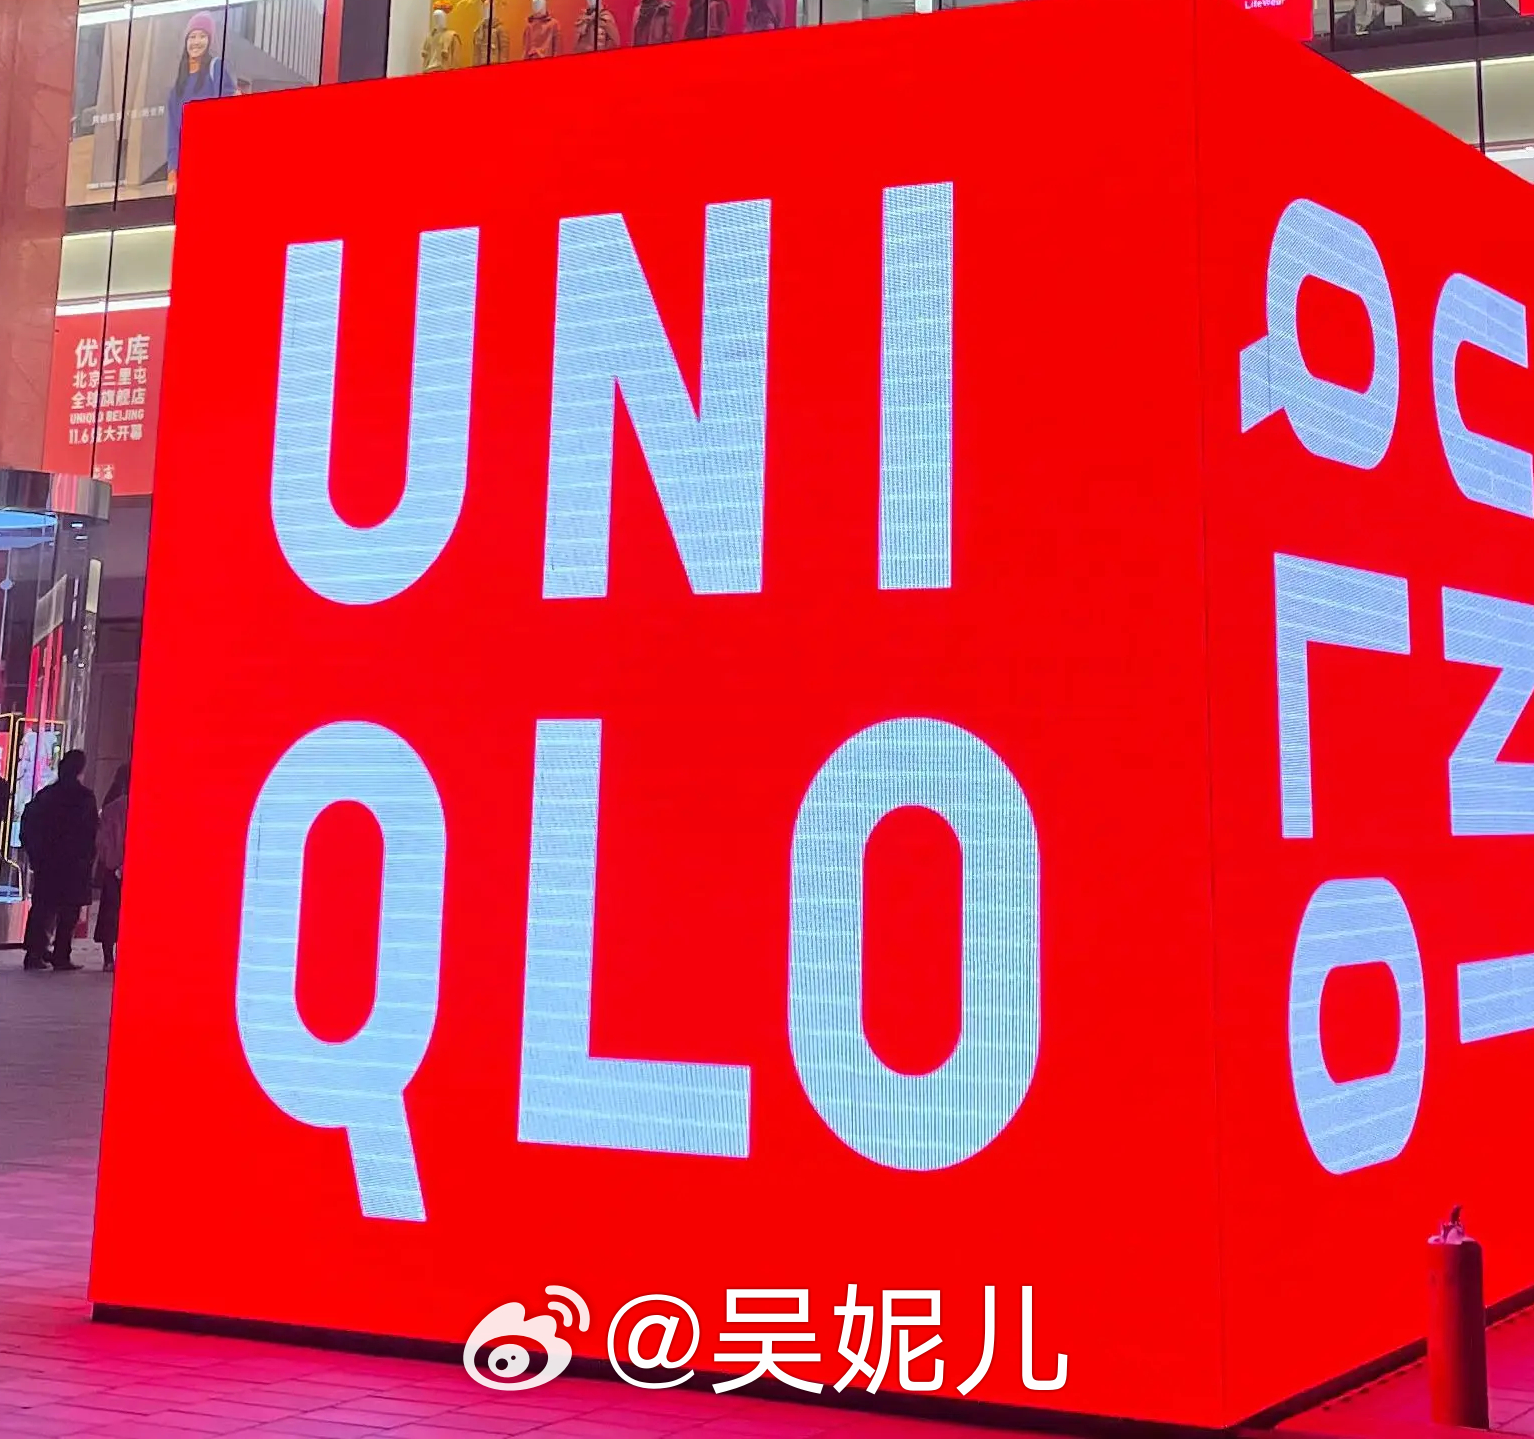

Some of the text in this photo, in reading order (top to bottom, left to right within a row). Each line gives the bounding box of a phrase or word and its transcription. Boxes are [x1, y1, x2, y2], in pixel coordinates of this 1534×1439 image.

[74, 333, 152, 370] 优衣库
[72, 366, 148, 389] 北京三里屯
[270, 181, 955, 606] UNI
[70, 387, 147, 410] 全球旗舰店
[105, 408, 145, 422] BEIJING
[1239, 197, 1426, 1176] QLO
[234, 716, 1041, 1222] QLO
